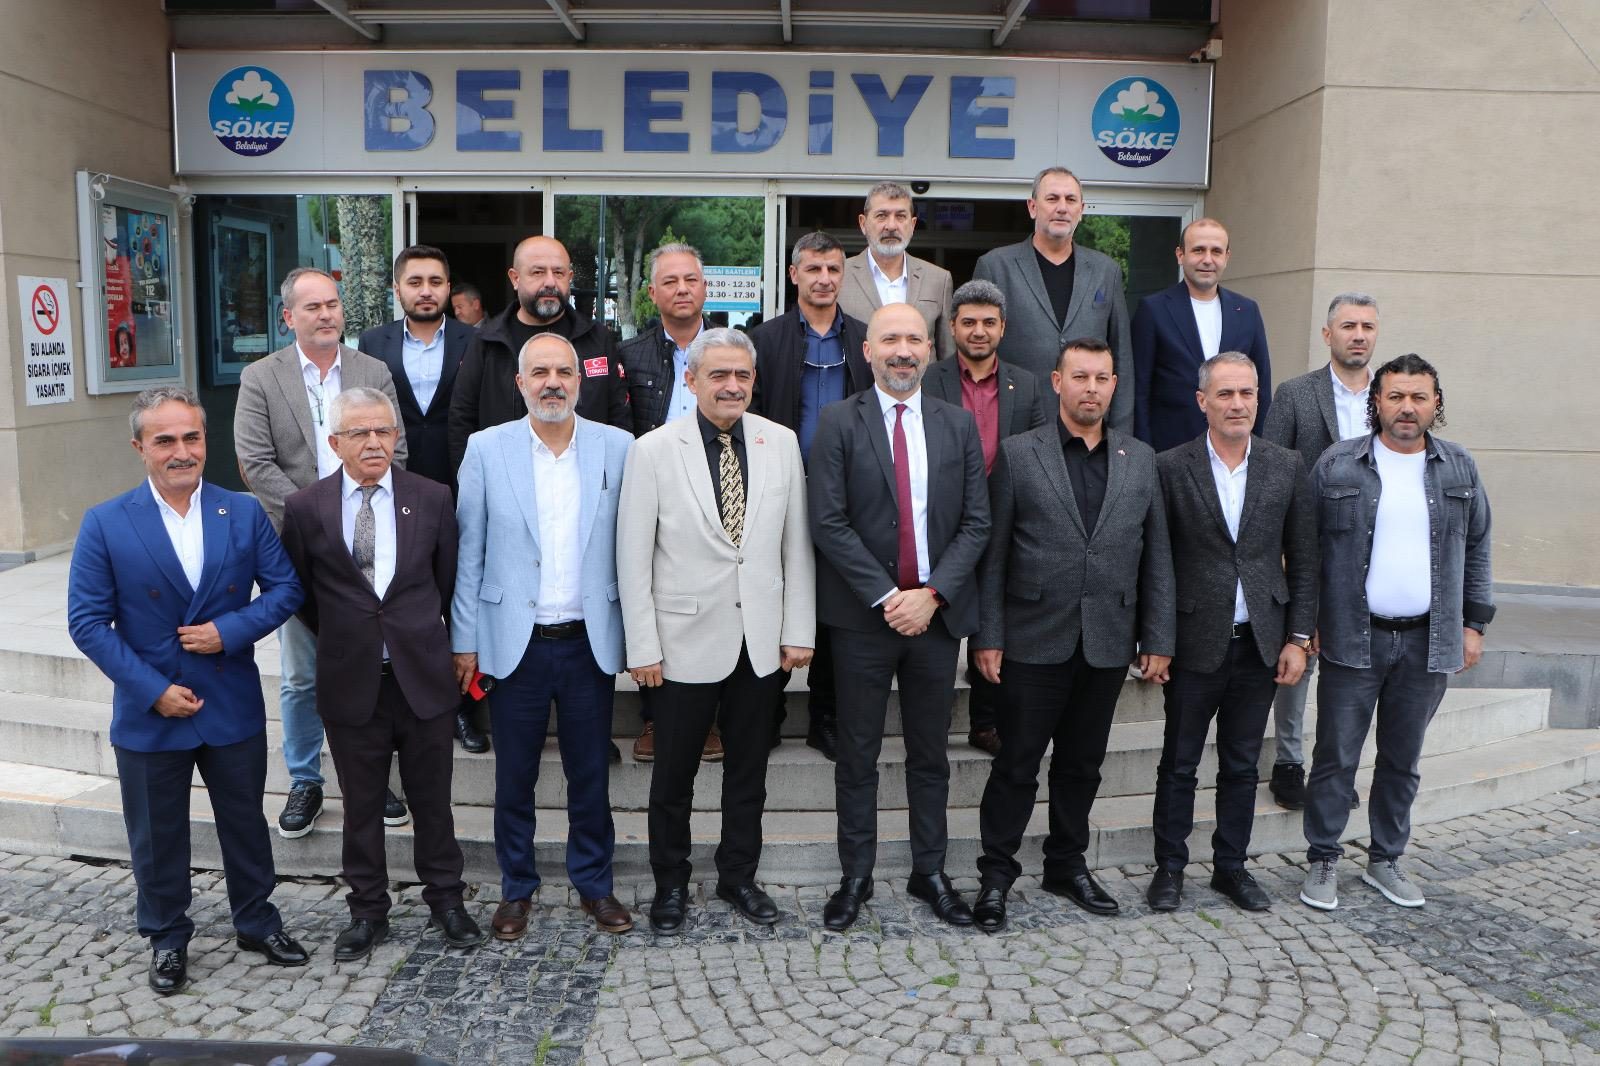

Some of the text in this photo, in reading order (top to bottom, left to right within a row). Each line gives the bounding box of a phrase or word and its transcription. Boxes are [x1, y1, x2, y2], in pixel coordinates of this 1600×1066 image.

[213, 116, 289, 138] SÖKE
[235, 140, 269, 152] Belediyesi
[1097, 127, 1175, 150] SÖKE
[1117, 151, 1152, 163] Belediyesi
[734, 291, 756, 299] 17.30
[31, 341, 66, 356] BU ALANDA
[35, 383, 66, 399] YASAKTIR
